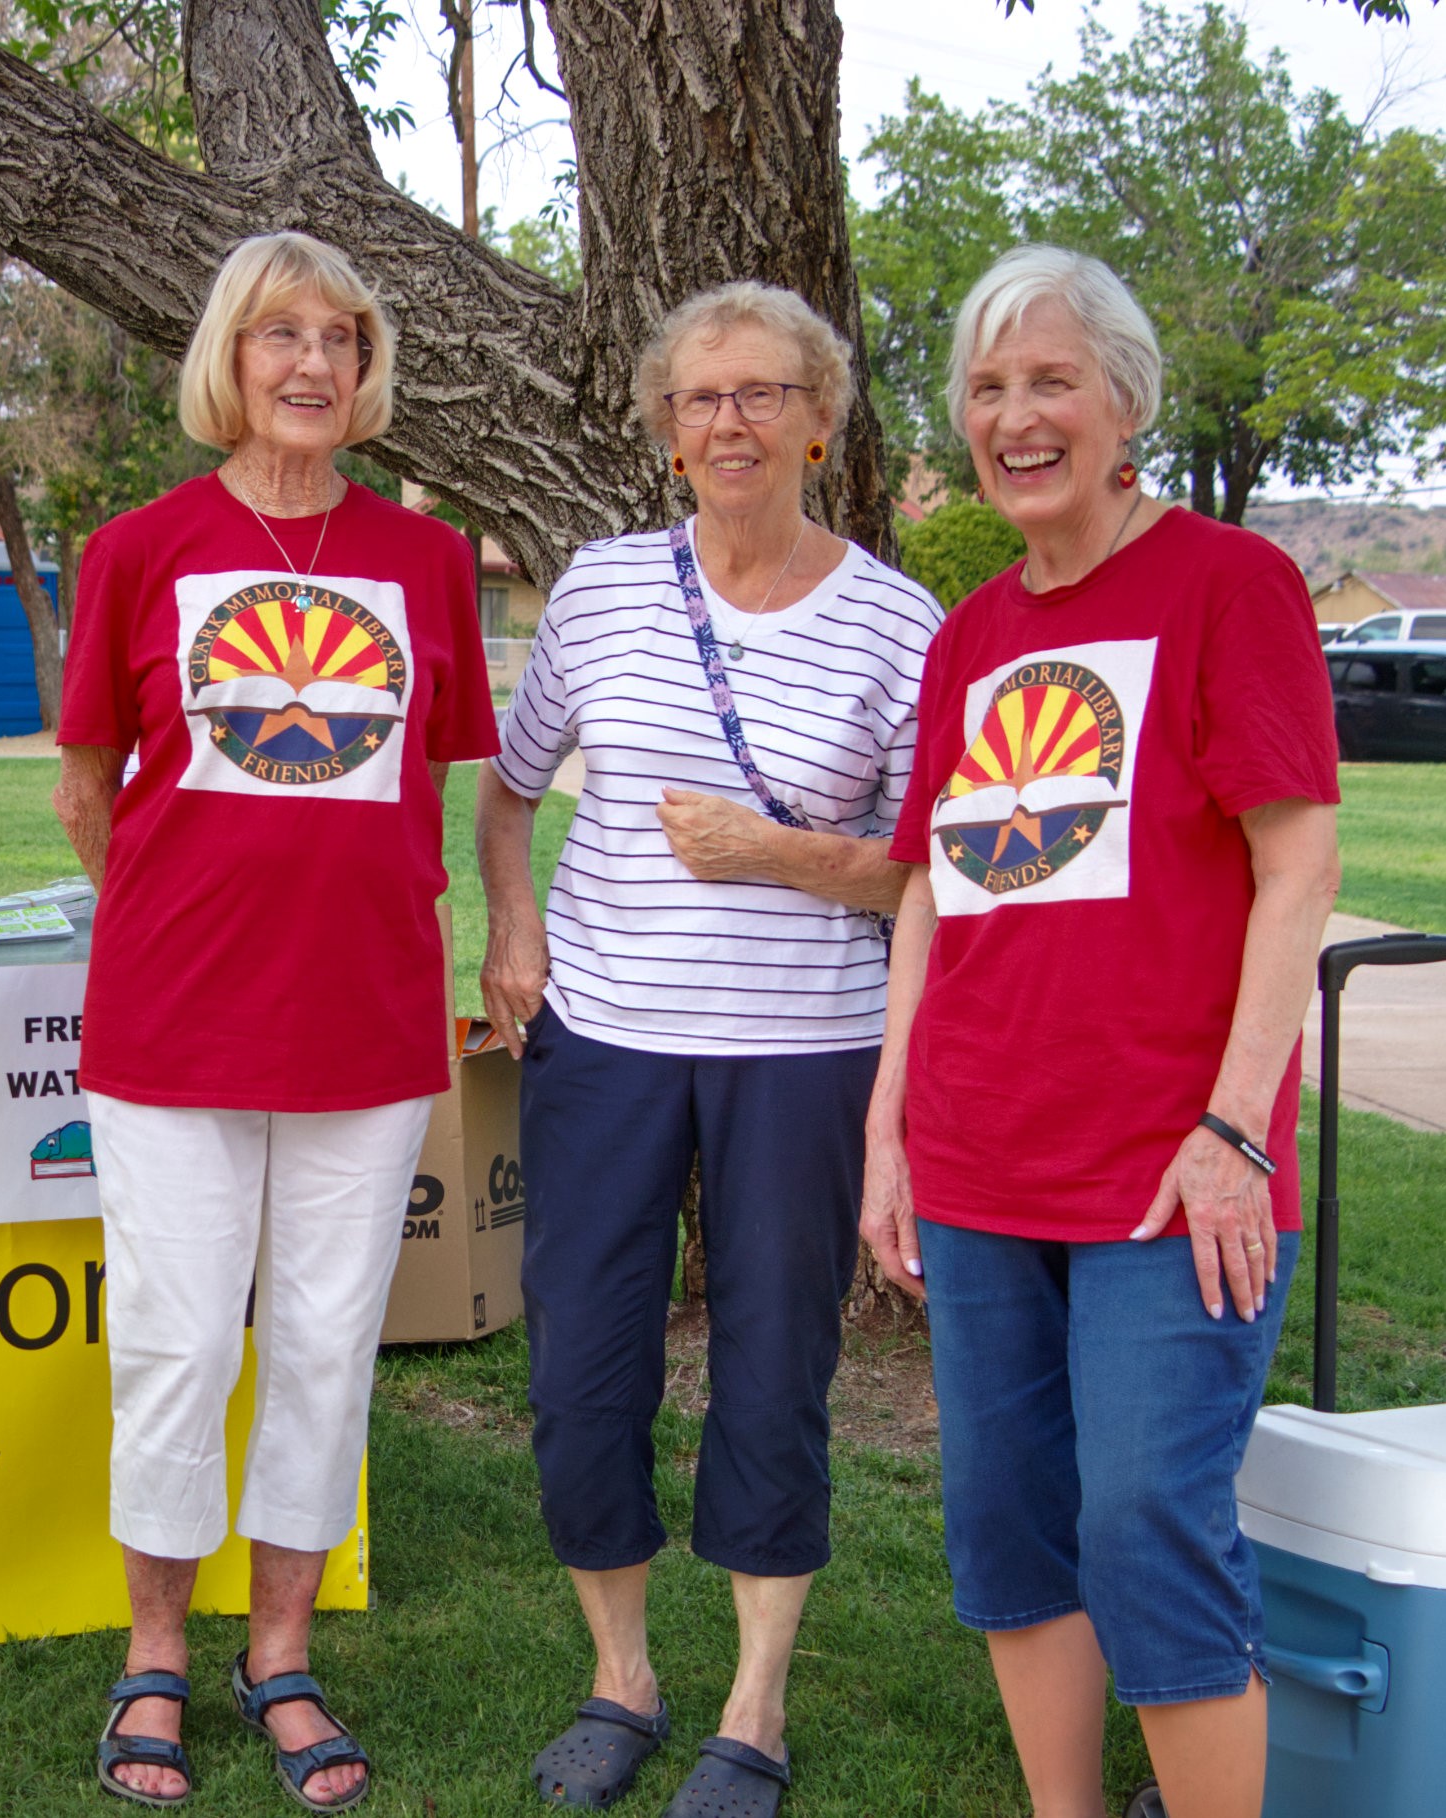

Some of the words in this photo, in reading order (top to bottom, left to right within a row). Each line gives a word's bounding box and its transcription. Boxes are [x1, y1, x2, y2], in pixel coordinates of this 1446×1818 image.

[191, 614, 225, 683] CLARK
[350, 608, 404, 689] LIBRARY
[988, 664, 1081, 708] EMORIAL
[1082, 679, 1120, 773] LIBRARY
[241, 752, 344, 783] FRIENDS
[983, 856, 1052, 890] FIENDS
[24, 1015, 82, 1043] FRE
[6, 1069, 81, 1098] WAT
